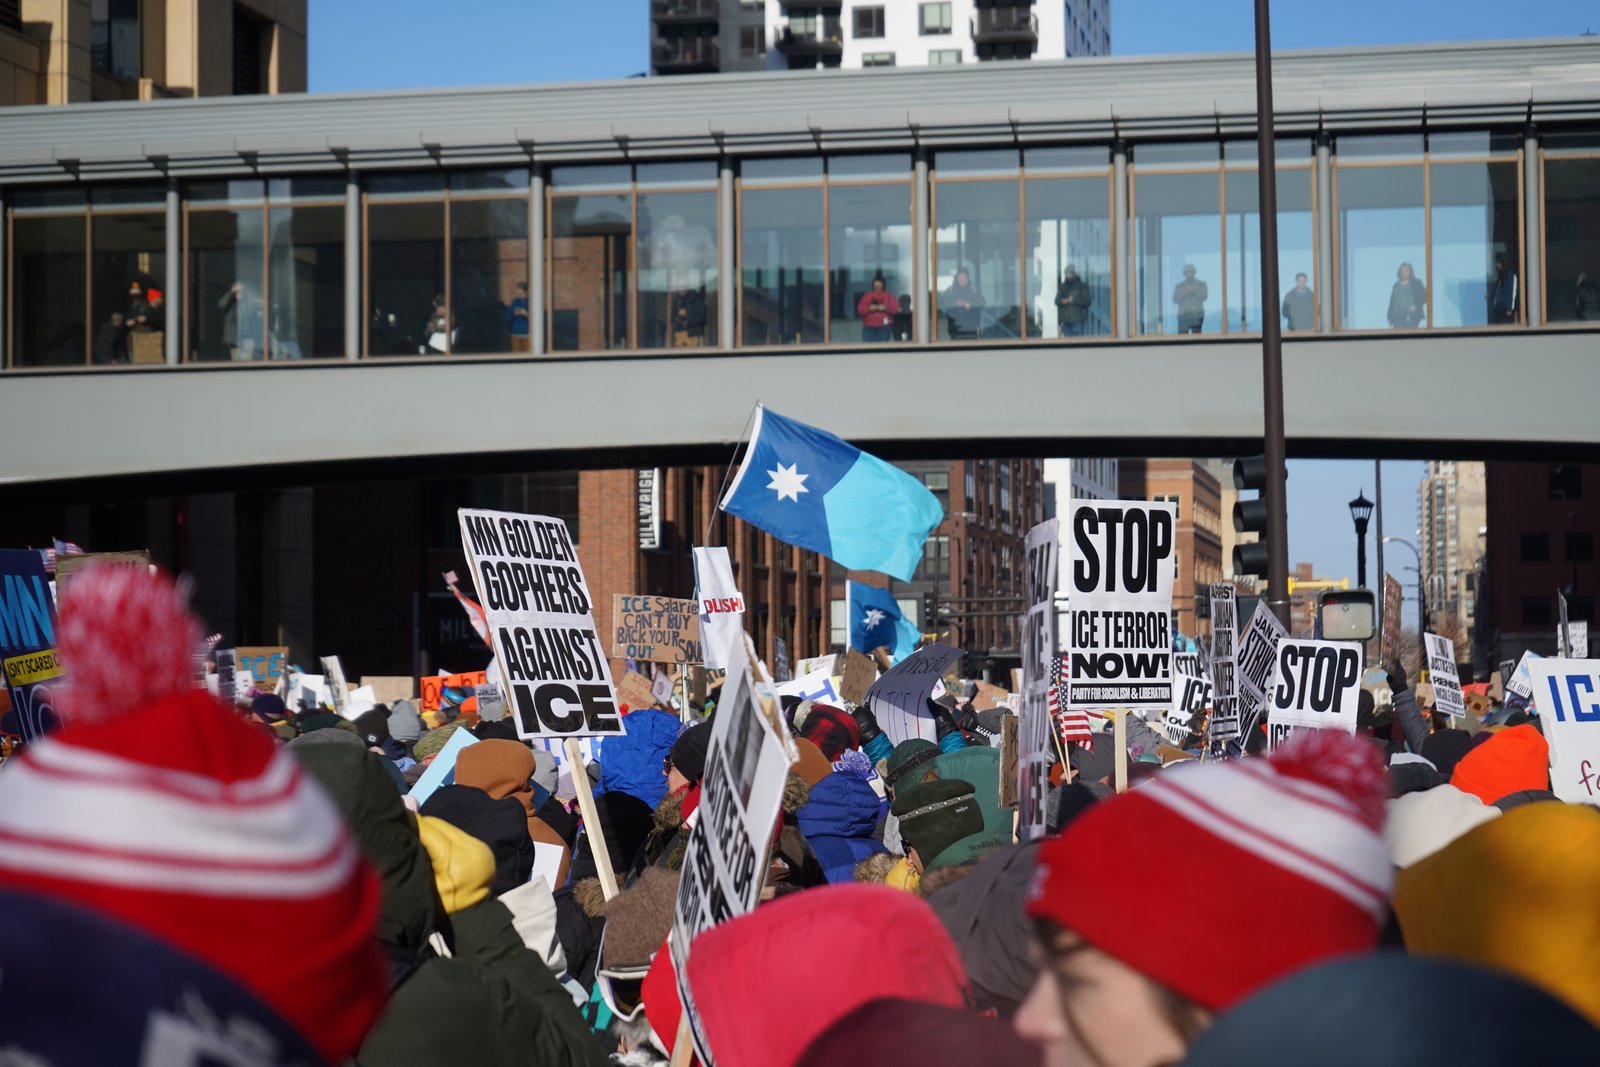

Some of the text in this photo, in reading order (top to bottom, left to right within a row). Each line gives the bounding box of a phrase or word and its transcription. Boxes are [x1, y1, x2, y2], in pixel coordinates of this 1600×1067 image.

[464, 515, 576, 562] MN GOLDEN
[1073, 506, 1171, 593] STOP
[480, 560, 590, 615] GOPHERS
[621, 597, 700, 615] ICE Salarie
[624, 613, 691, 630] CAN'T BUY
[617, 626, 681, 647] BACK YOUR
[1072, 610, 1098, 648] ICE
[1102, 611, 1168, 649] TERROR
[7, 655, 26, 678] ISN'T
[25, 653, 54, 675] SCARED
[240, 654, 282, 680] ICE
[498, 627, 605, 681] AGAINST
[626, 644, 654, 659] OUT
[1071, 652, 1170, 679] NOW!
[1071, 686, 1171, 700] PARTY FOR SOCIALISM & LIBERATION
[1275, 645, 1359, 713] STOP
[513, 683, 621, 734] ICE
[1180, 678, 1212, 714] ICE
[1547, 674, 1600, 722] IC
[1169, 717, 1190, 728] OU
